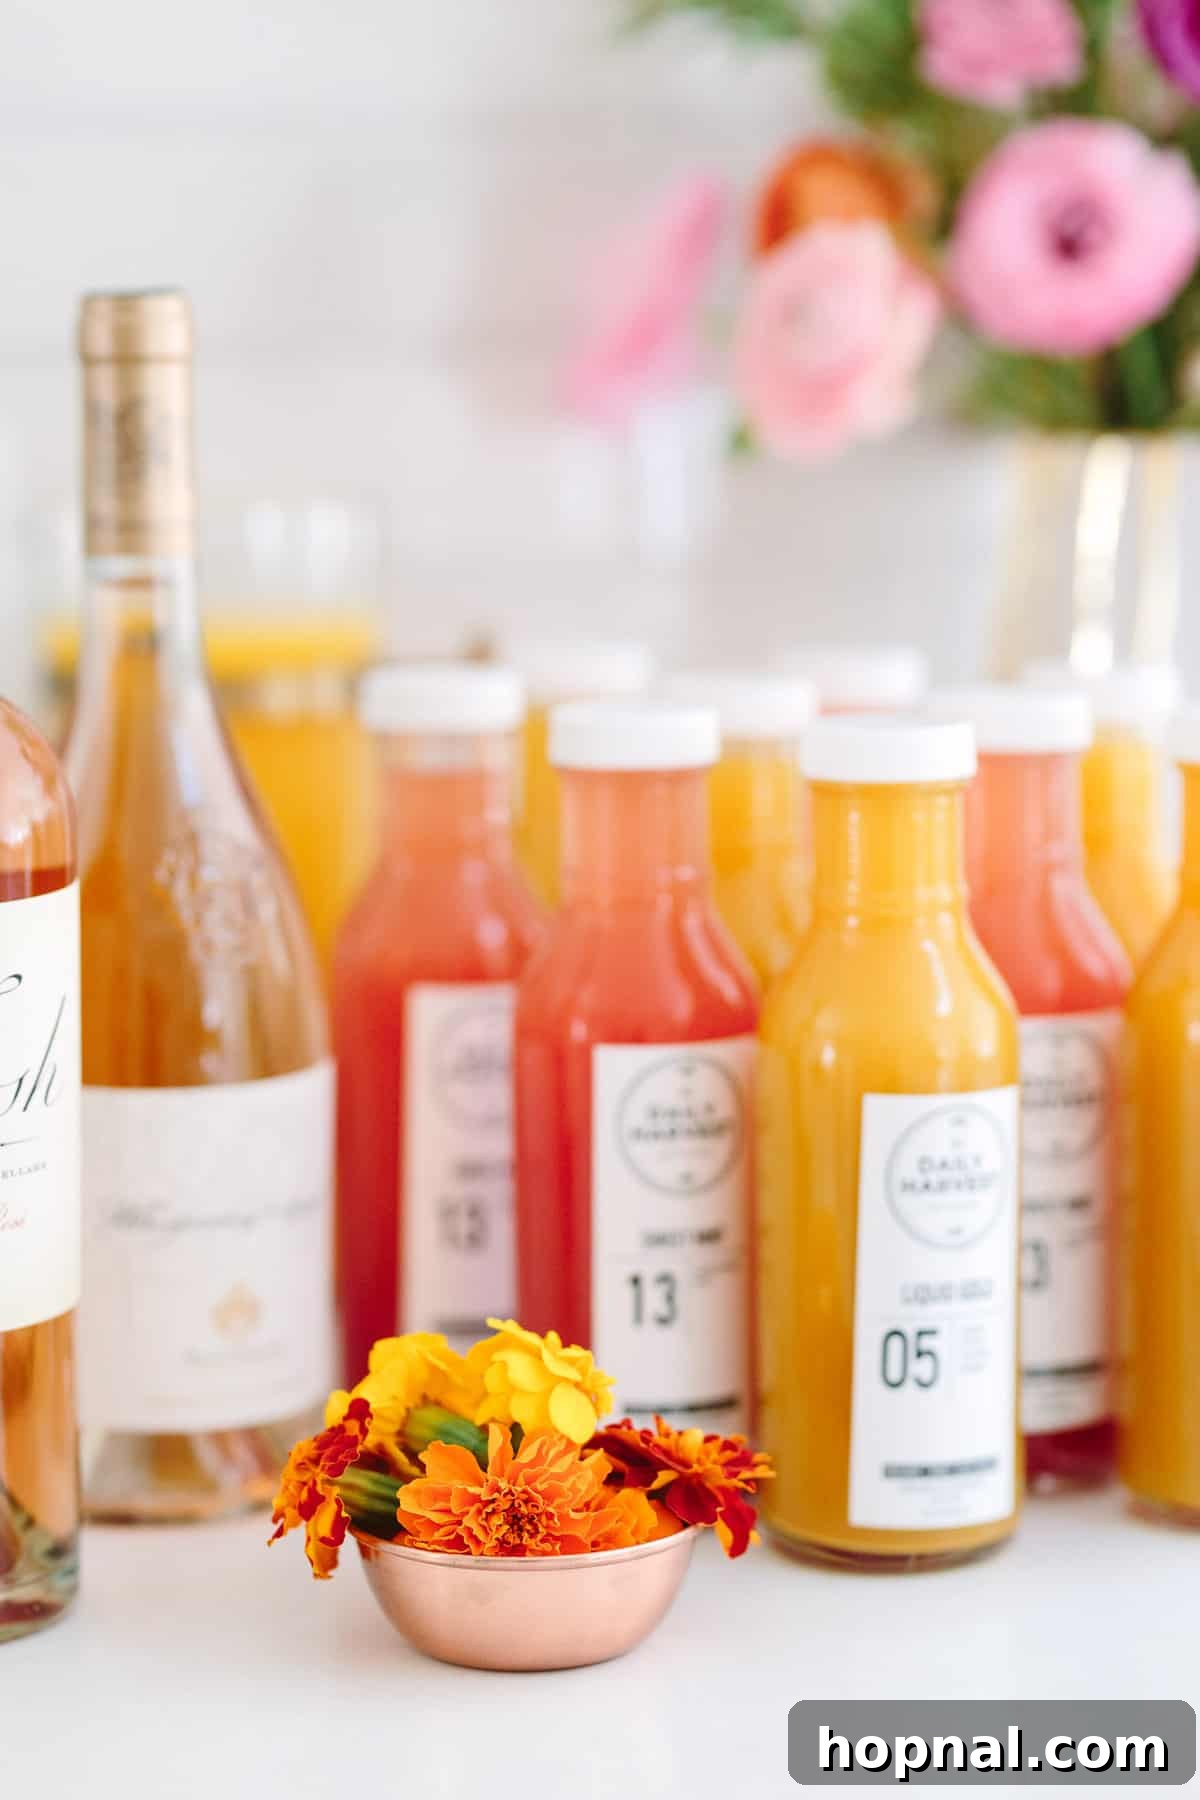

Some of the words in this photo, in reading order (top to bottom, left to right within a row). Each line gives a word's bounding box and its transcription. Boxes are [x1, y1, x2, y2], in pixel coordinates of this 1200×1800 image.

[917, 1152, 984, 1175] DAILY
[627, 1271, 678, 1328] 13
[880, 1327, 941, 1390] 05
